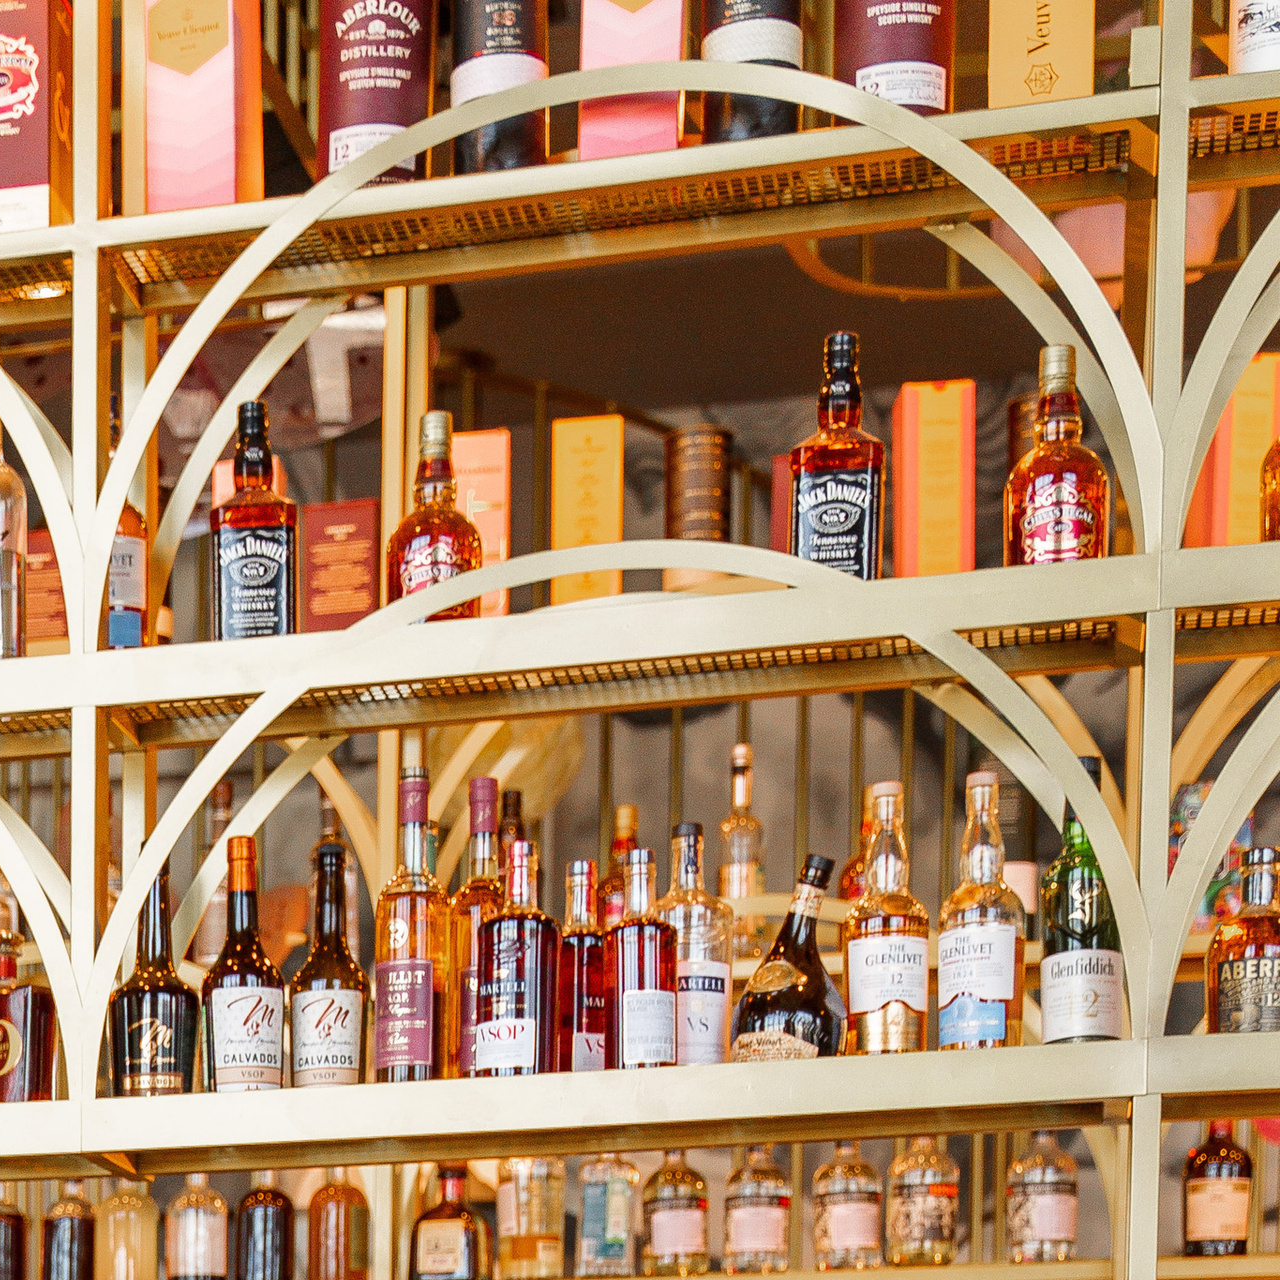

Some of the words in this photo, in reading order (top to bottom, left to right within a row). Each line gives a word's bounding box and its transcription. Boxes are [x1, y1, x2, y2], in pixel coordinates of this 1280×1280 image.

[866, 4, 902, 18] SPEYSIDE
[903, 2, 926, 13] SINGLE
[927, 3, 942, 16] MALT
[335, 0, 422, 39] ABERLOUR
[877, 14, 906, 26] SCOTCH
[907, 13, 933, 25] WHISKY
[340, 45, 412, 62] DISTILLERY
[333, 143, 350, 161] 12
[798, 486, 827, 514] JACK
[1024, 508, 1062, 530] CHIVAS
[1063, 507, 1094, 525] REGAL
[809, 534, 858, 546] Tennessee
[220, 542, 247, 567] JACK
[809, 549, 857, 561] WHISKEY
[231, 586, 277, 599] Tennessee
[231, 602, 276, 612] WHISKEY
[954, 936, 971, 945] THE
[888, 944, 906, 953] THE
[939, 943, 994, 963] GLENLIVET
[865, 952, 924, 967] GLENLIVET
[1050, 956, 1116, 981] Glenfiddich
[678, 978, 726, 992] ARTELL
[890, 972, 903, 985] 12
[479, 981, 527, 997] MARTELL
[686, 1016, 710, 1032] VS
[479, 1023, 526, 1044] VSOP
[223, 1053, 278, 1065] CALVADOS
[298, 1055, 354, 1068] CALVADOS
[240, 1070, 266, 1079] VSOP
[312, 1072, 337, 1081] VSOP
